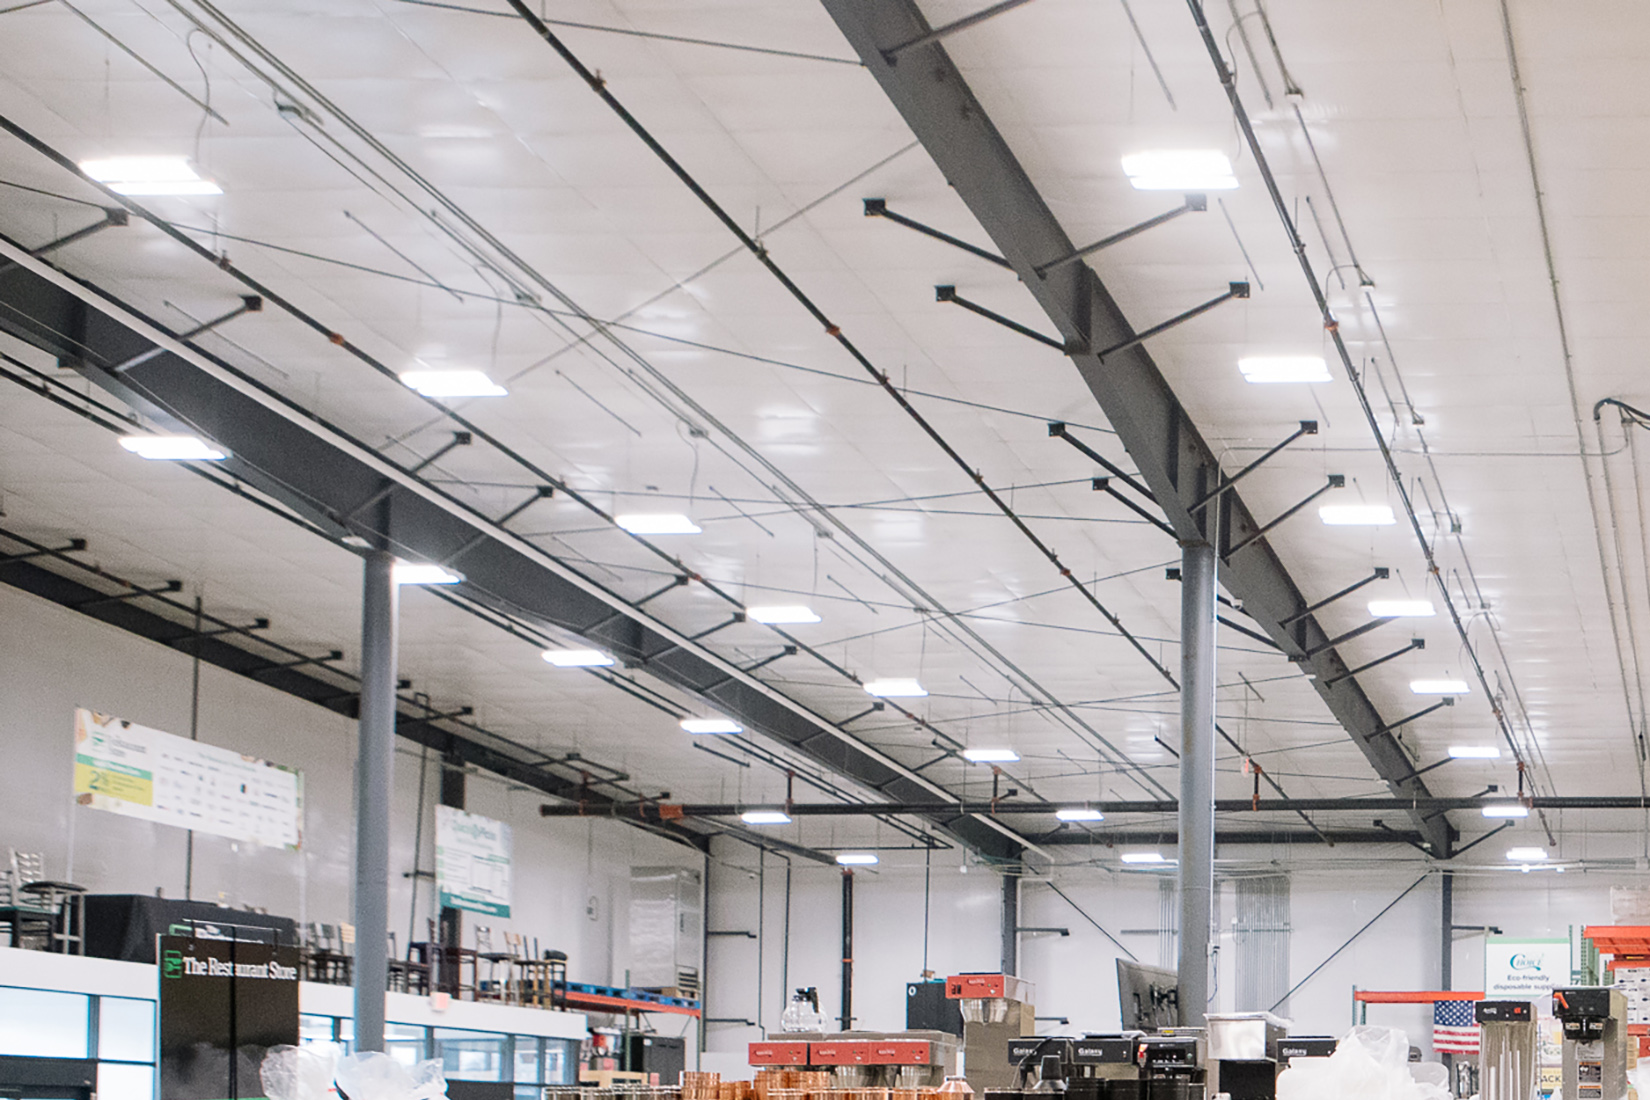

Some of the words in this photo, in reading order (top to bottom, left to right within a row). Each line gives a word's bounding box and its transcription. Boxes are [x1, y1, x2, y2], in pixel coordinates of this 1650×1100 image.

[183, 956, 208, 976] The
[269, 961, 297, 980] Store
[1507, 974, 1549, 983] Eco-friendly
[1078, 1047, 1102, 1056] Galaxy
